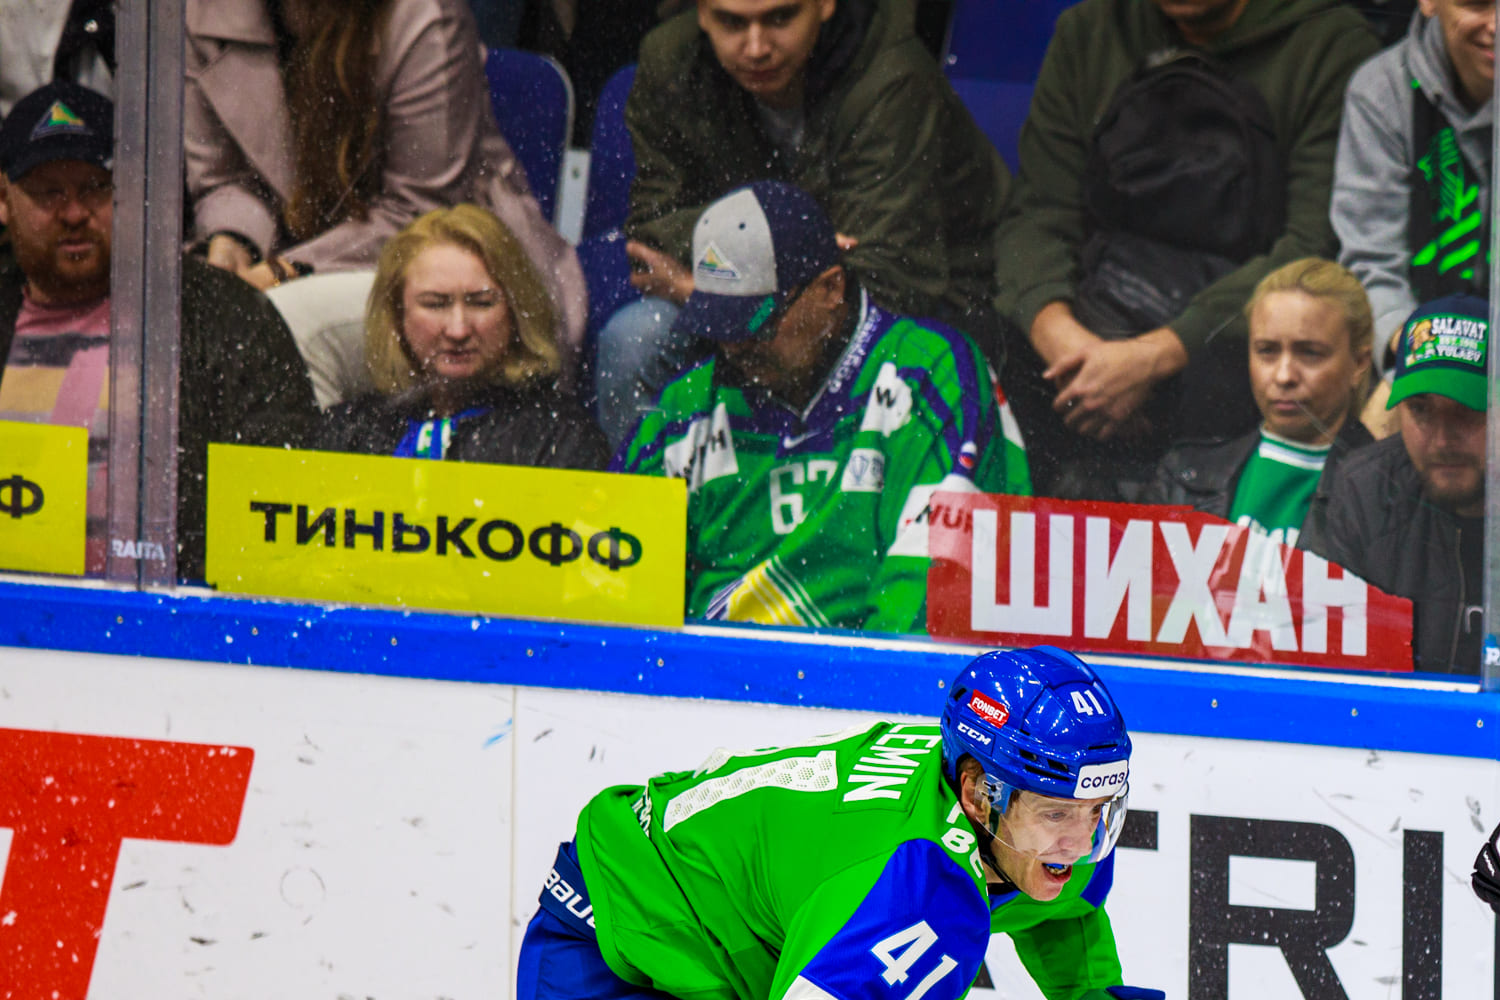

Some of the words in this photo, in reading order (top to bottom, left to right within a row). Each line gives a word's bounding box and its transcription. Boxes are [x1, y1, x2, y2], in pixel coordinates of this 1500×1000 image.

[1431, 316, 1487, 340] SALAVAT
[770, 459, 838, 535] 67
[250, 501, 642, 571] ТИНЬКОФФ
[971, 509, 1367, 656] ШИХАН
[971, 696, 1007, 722] FONBET
[1070, 689, 1105, 716] 41
[957, 721, 992, 746] CCM
[842, 723, 942, 803] EMIN
[1080, 770, 1125, 789] согаз
[544, 867, 597, 929] BAU
